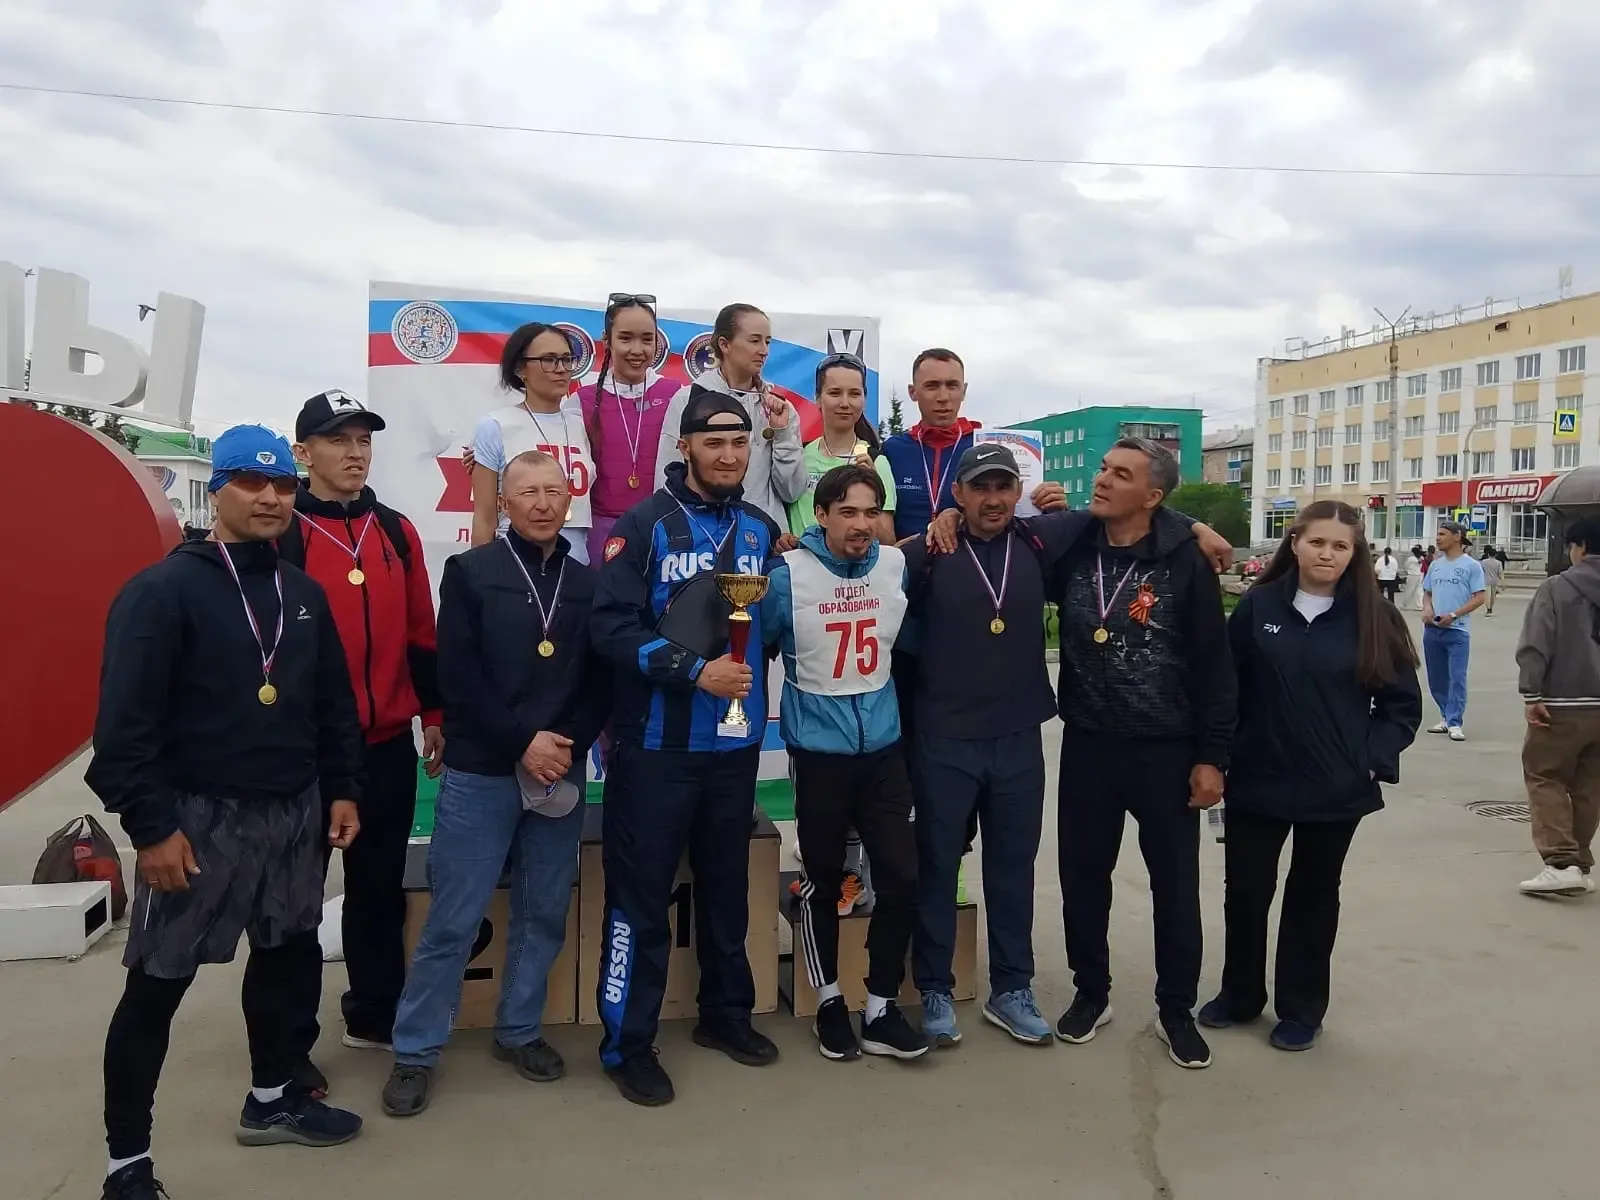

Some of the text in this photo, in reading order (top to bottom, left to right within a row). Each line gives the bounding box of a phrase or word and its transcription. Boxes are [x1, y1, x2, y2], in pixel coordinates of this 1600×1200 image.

[1480, 482, 1538, 498] МАГНИТ
[834, 585, 866, 600] ОТДЕЛ
[818, 598, 880, 615] ОБРАЗОВАНИЯ
[825, 618, 879, 679] 75
[605, 920, 632, 1004] RUSSIA
